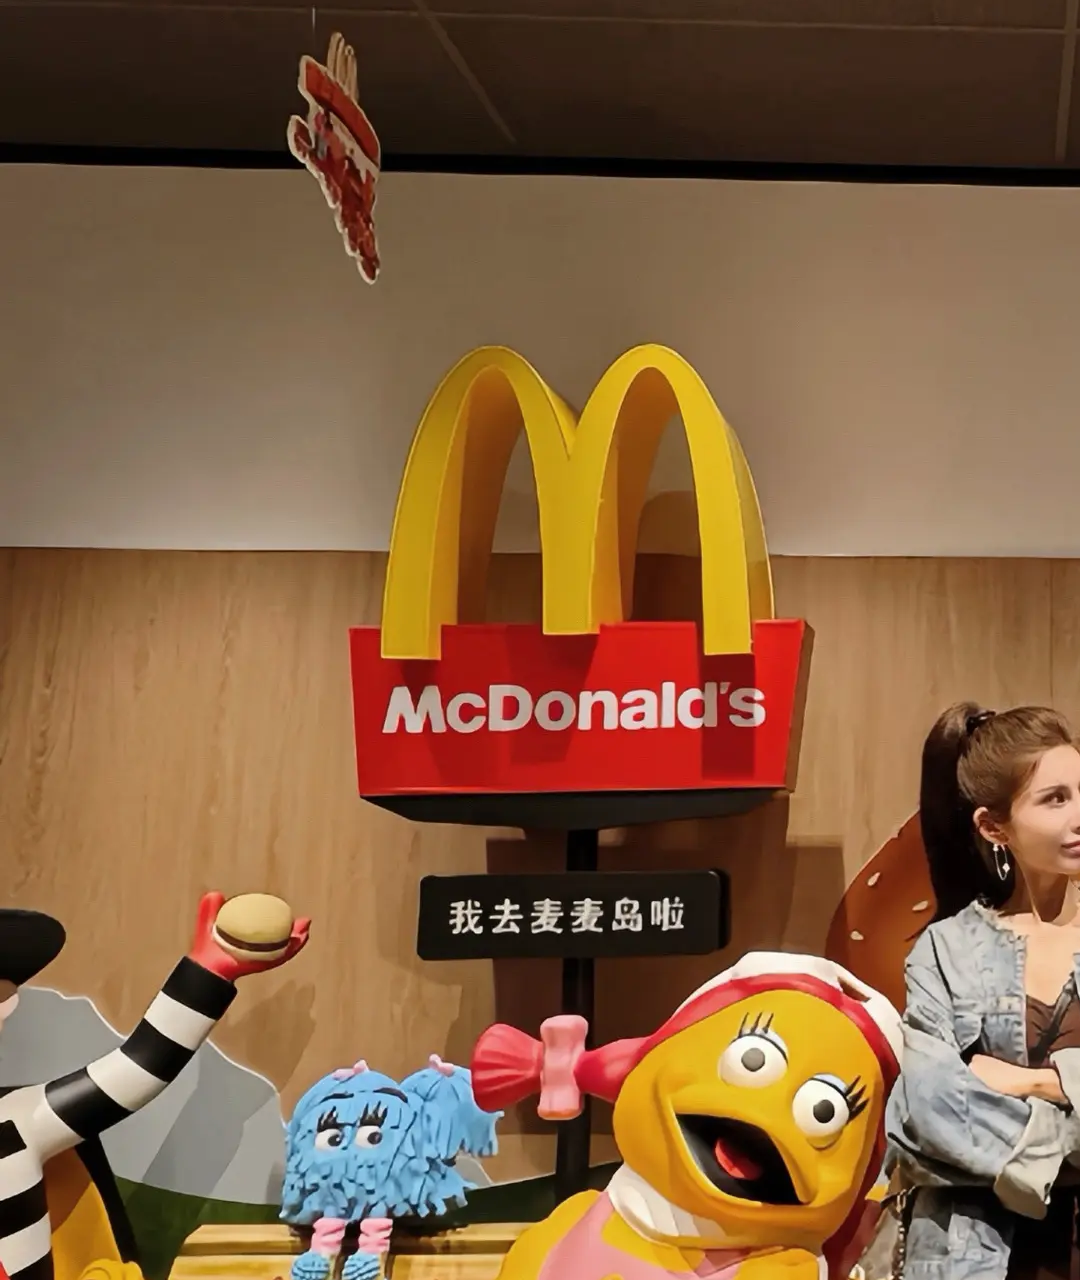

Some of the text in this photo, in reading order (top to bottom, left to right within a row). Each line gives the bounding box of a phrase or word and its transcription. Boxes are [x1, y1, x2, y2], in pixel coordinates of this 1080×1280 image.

[381, 681, 767, 734] McDonald's
[449, 896, 685, 935] 我去麦麦岛啦
